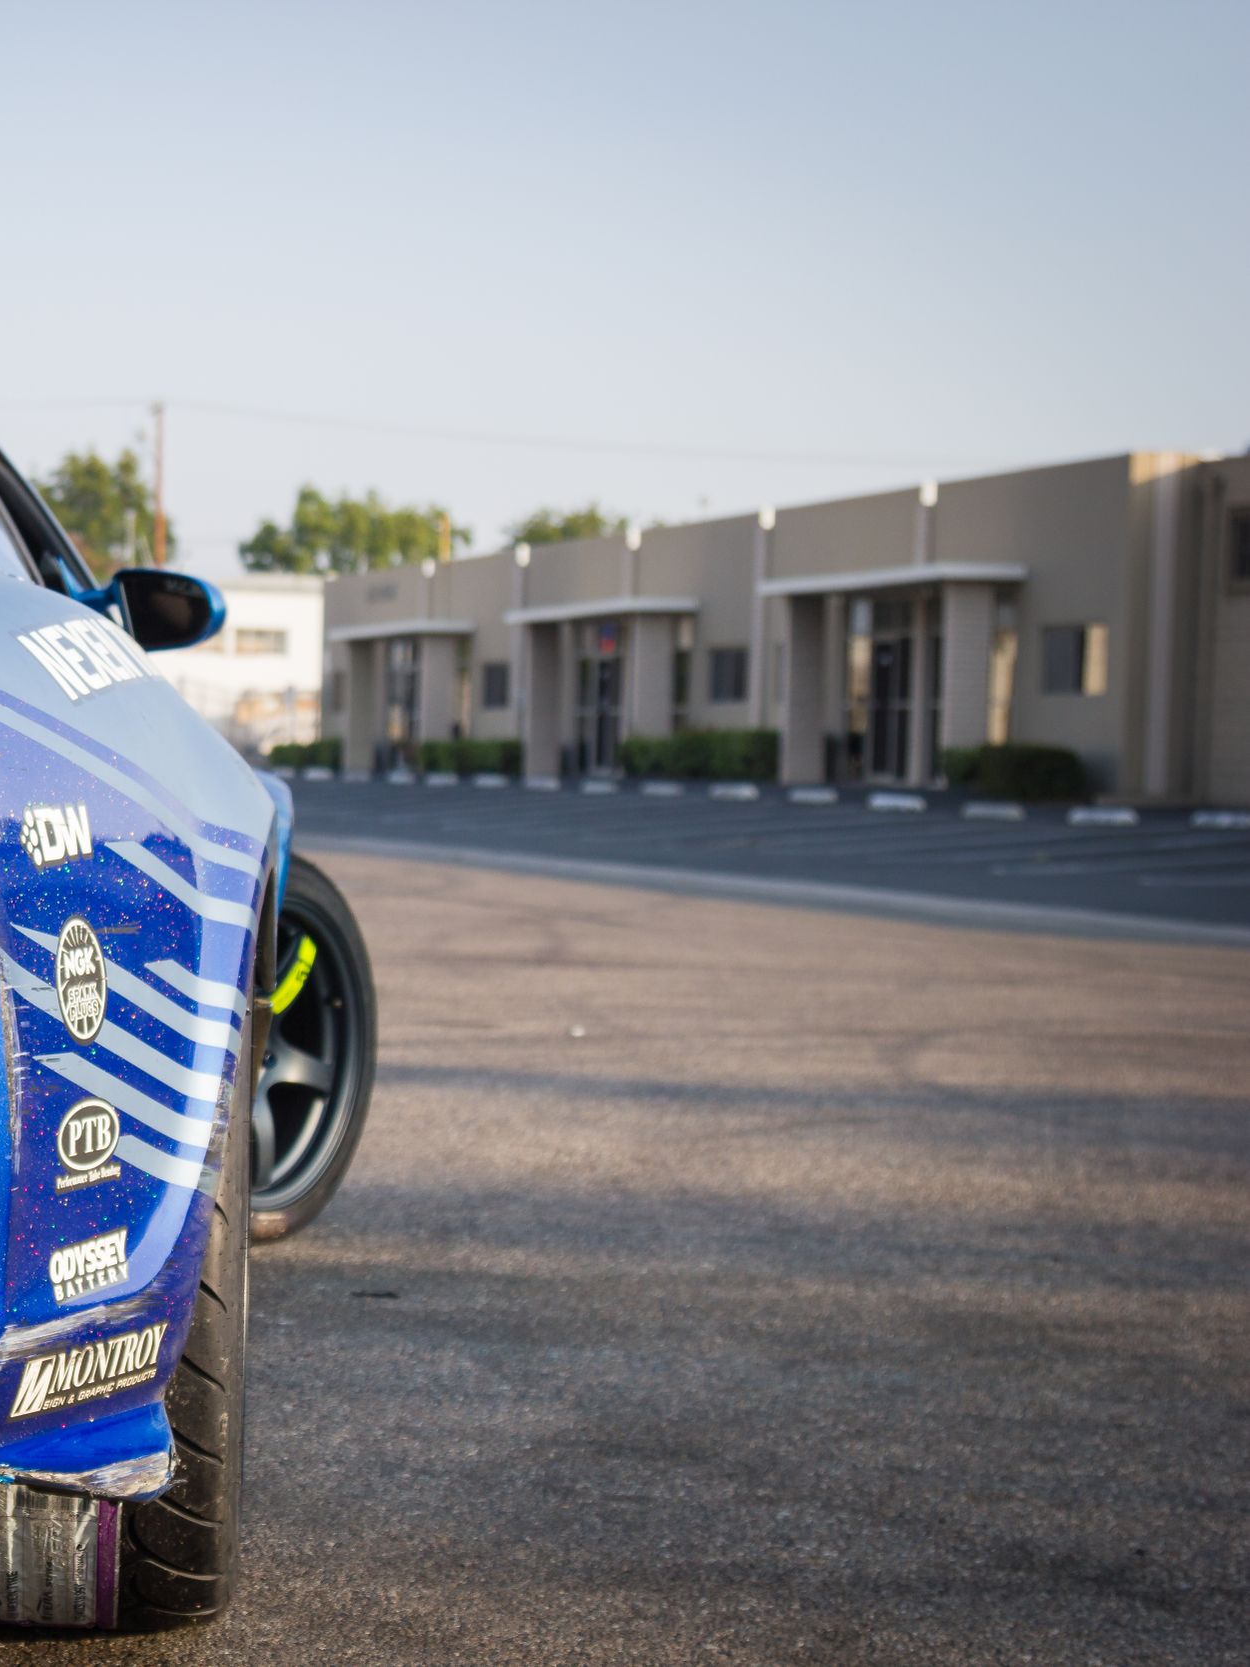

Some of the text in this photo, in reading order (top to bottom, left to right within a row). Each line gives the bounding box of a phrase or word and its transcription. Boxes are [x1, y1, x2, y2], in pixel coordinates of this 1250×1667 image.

[63, 946, 96, 979] NGK
[68, 982, 97, 1003] SPARK
[69, 999, 98, 1021] PLUGS
[68, 1114, 112, 1157] PTB
[50, 1230, 128, 1284] ODYSSEY
[53, 1262, 129, 1301] BATTERY
[48, 1323, 168, 1394] MONTROY
[42, 1368, 157, 1410] SIGN & GRAPHIC PRODUCTS
